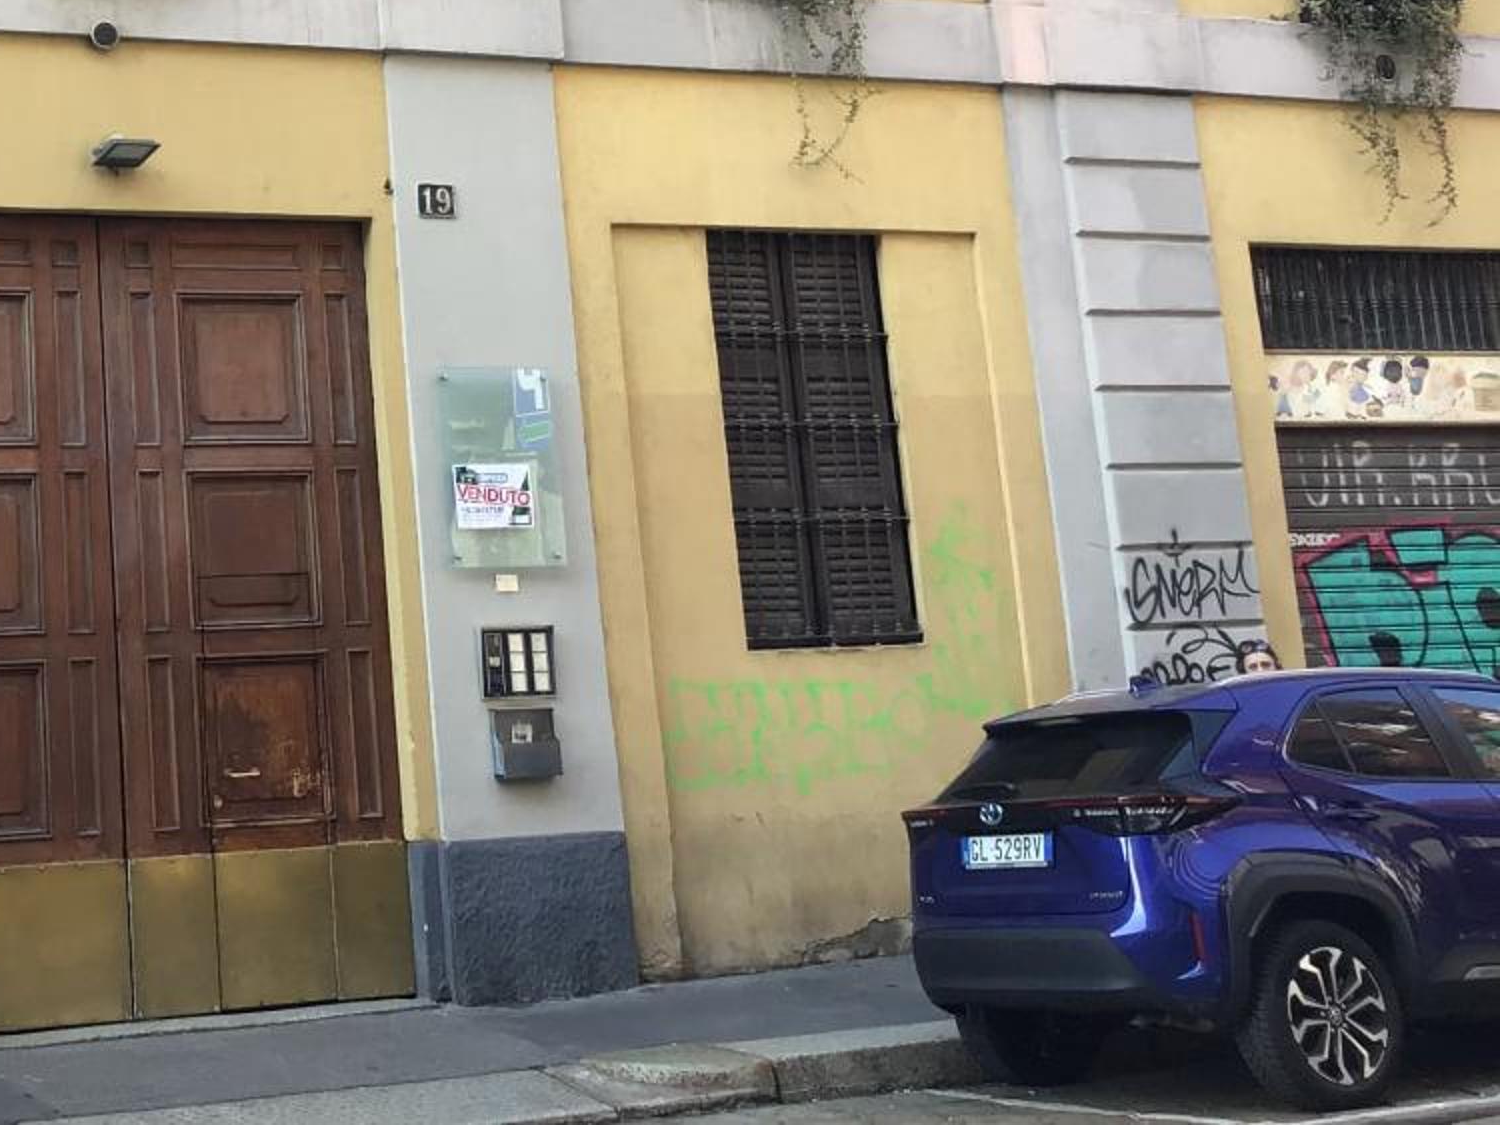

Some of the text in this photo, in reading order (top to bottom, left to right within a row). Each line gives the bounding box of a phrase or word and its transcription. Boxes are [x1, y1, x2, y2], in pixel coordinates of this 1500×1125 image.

[421, 186, 452, 215] 19
[457, 484, 532, 507] VENDUTO
[995, 838, 1041, 860] 529RV
